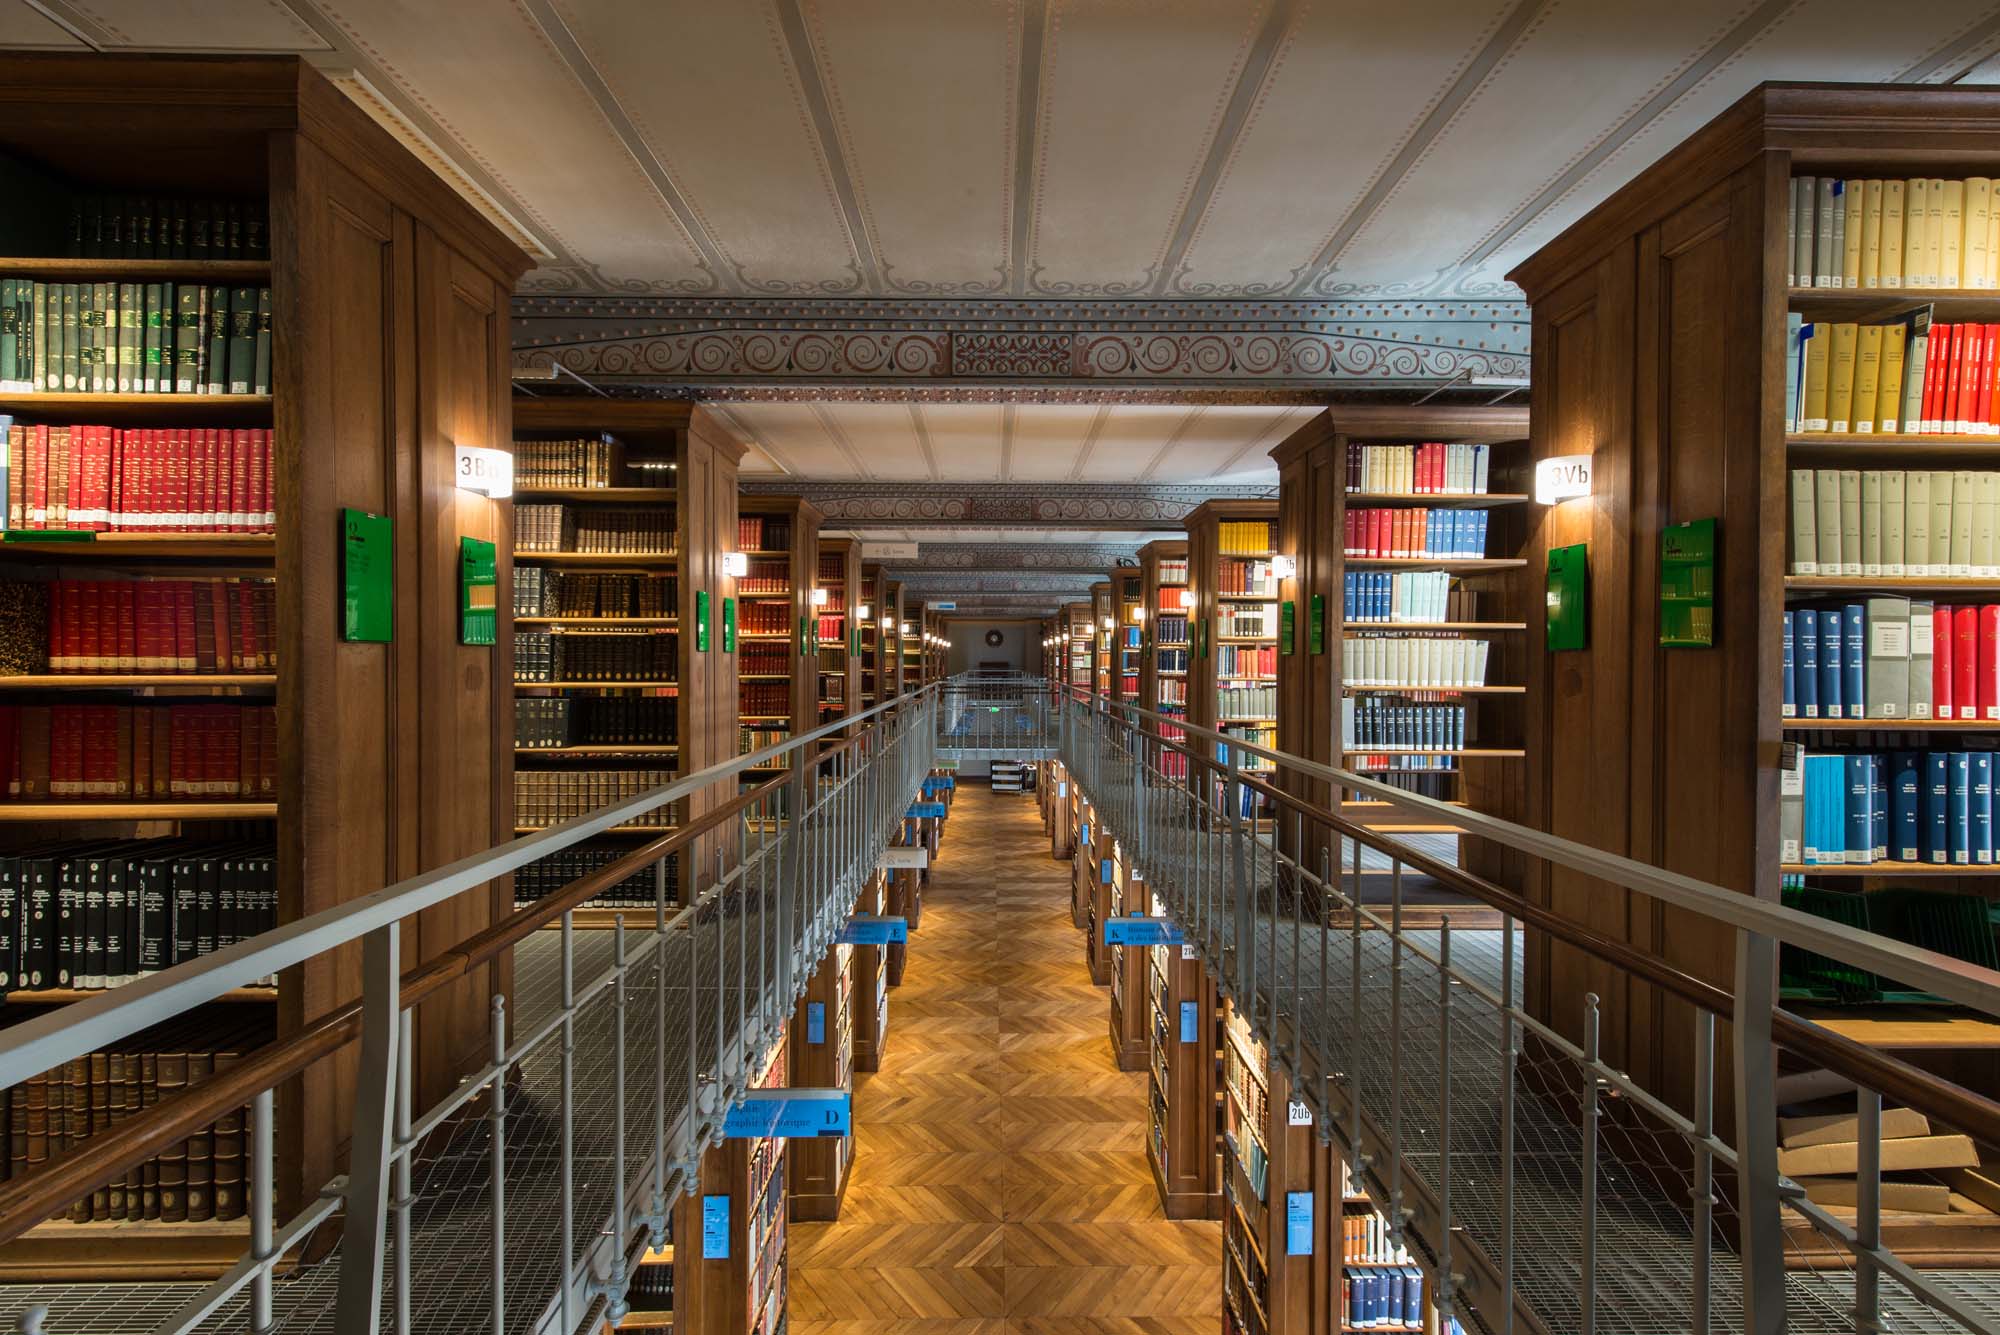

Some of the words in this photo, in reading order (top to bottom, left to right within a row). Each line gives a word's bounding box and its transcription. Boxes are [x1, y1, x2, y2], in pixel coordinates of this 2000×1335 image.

[1552, 464, 1588, 487] 3Vb
[1111, 928, 1119, 939] K
[825, 1110, 839, 1125] D
[1291, 1107, 1310, 1119] 2Ub
